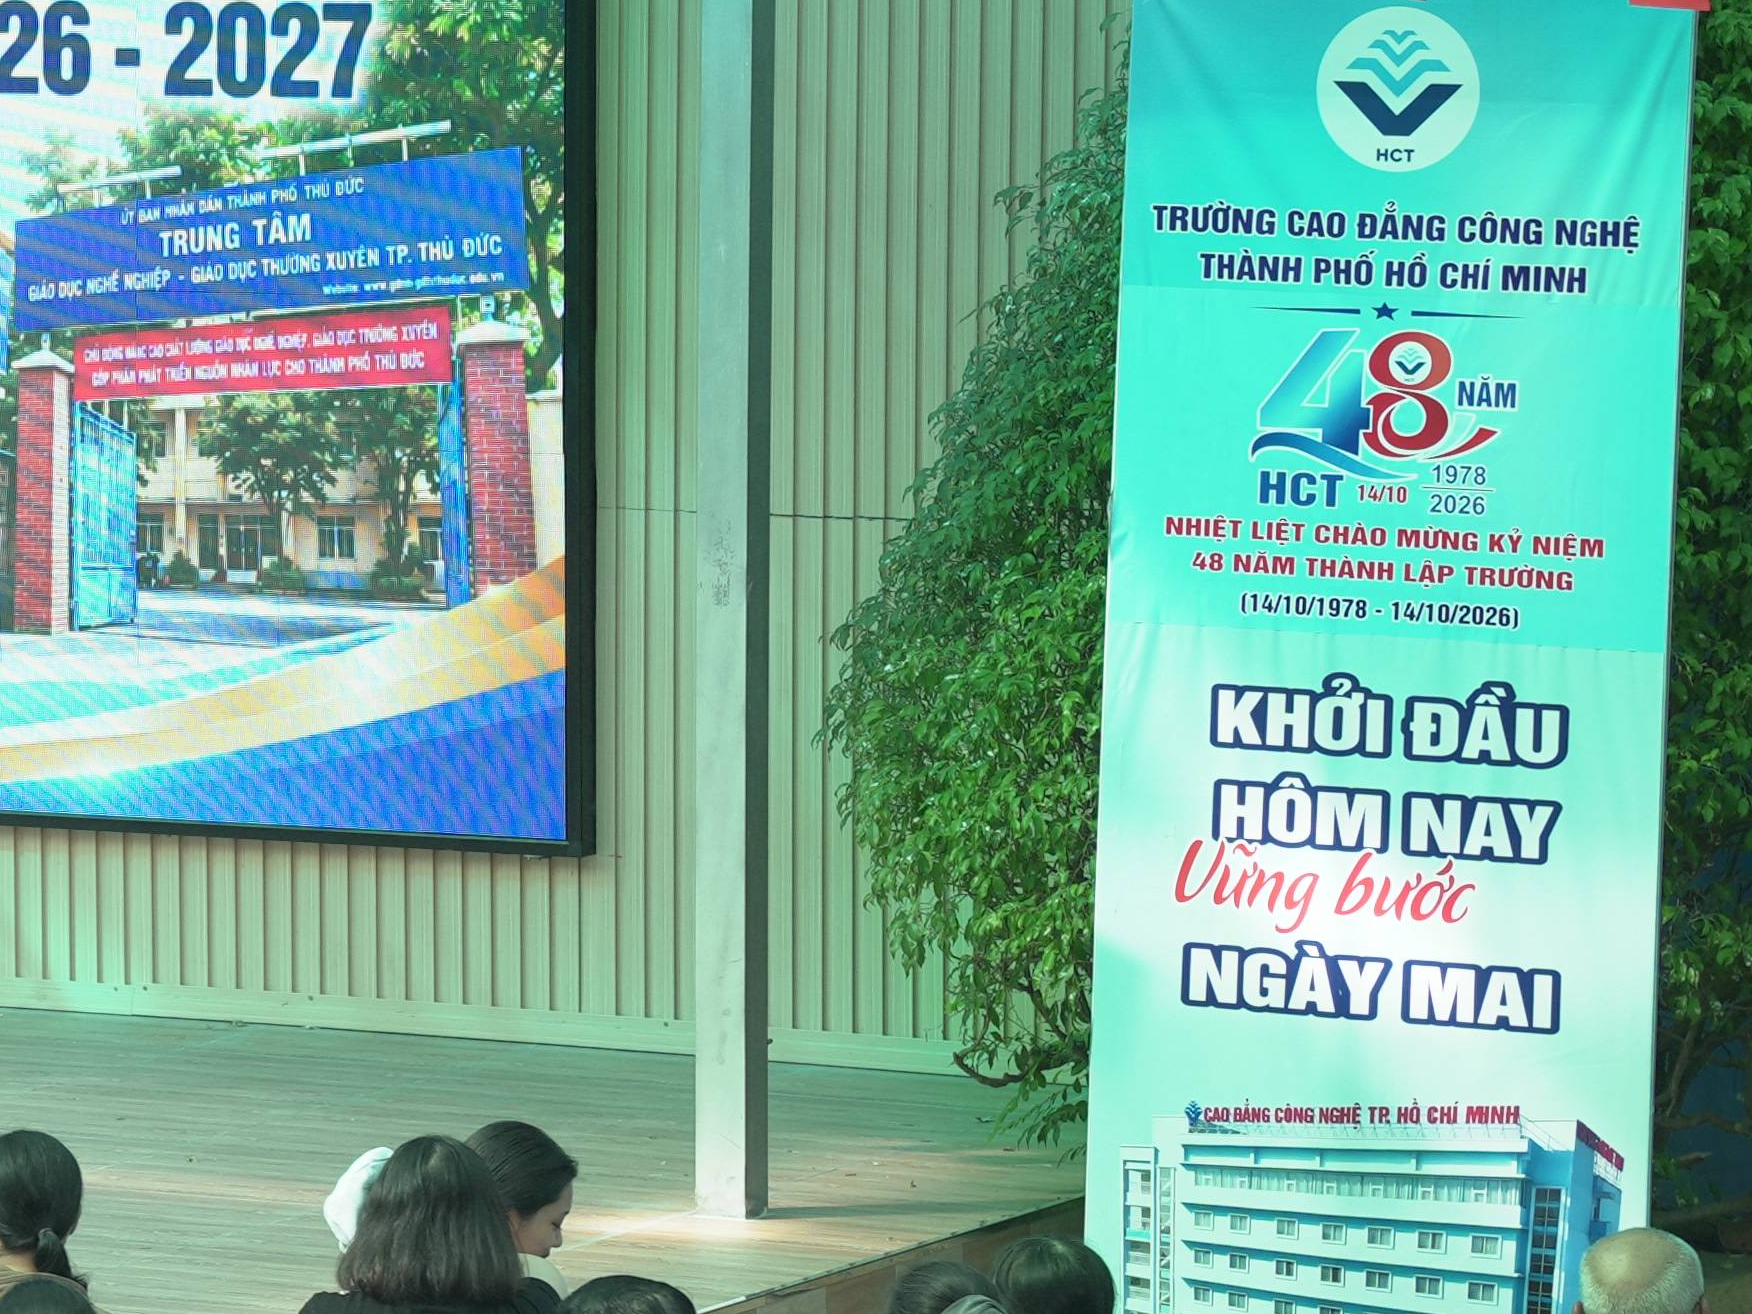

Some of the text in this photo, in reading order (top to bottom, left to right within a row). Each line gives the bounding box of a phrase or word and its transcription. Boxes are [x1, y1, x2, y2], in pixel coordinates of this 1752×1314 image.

[163, 2, 373, 99] 2027
[1376, 148, 1416, 164] HCT
[159, 211, 312, 257] TRUNG TÂM
[1153, 201, 1640, 254] TRƯỜNG CAO ĐẲNG CÔNG NGHỆ
[1201, 249, 1587, 293] THÀNH PHỐ HỒ CHÍ MINH
[1258, 327, 1517, 459] 48 NĂM
[1259, 470, 1407, 507] HCT 14/10
[1432, 465, 1487, 485] 1978
[1430, 494, 1485, 516] 2026
[1165, 516, 1604, 562] NHIỆT LIỆT CHÀO MỪNG KỶ NIỆM
[1241, 592, 1519, 630] (14/10/1978 14/10/2026)
[1211, 673, 1569, 769] KHỞI ĐẦU
[1212, 771, 1563, 864] HÔM NAY
[1174, 838, 1475, 934] Vững bước
[1180, 940, 1561, 1034] NGÀY MAI
